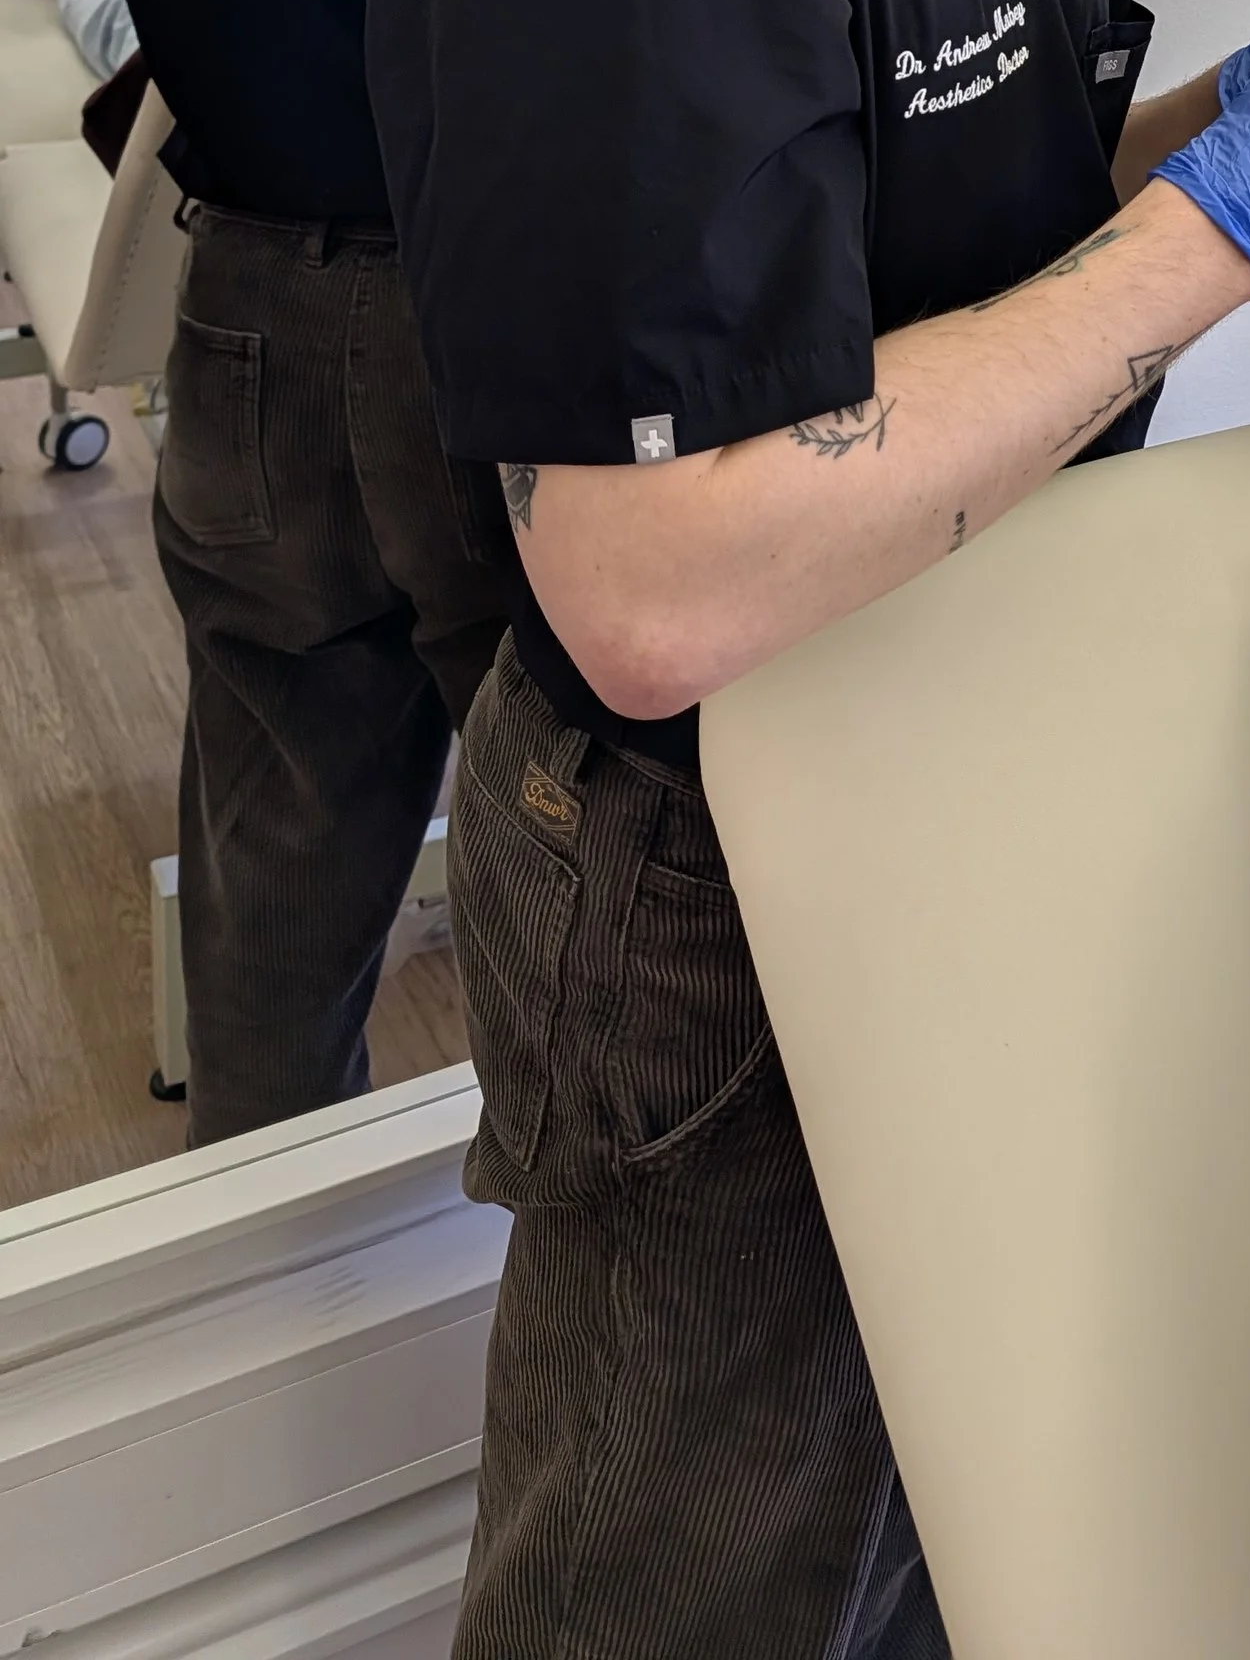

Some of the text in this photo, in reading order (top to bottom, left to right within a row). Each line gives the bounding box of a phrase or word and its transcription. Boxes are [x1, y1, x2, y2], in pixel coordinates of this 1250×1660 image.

[895, 50, 926, 80] Dr
[933, 35, 992, 71] Andrew
[904, 74, 994, 119] Aesthetics
